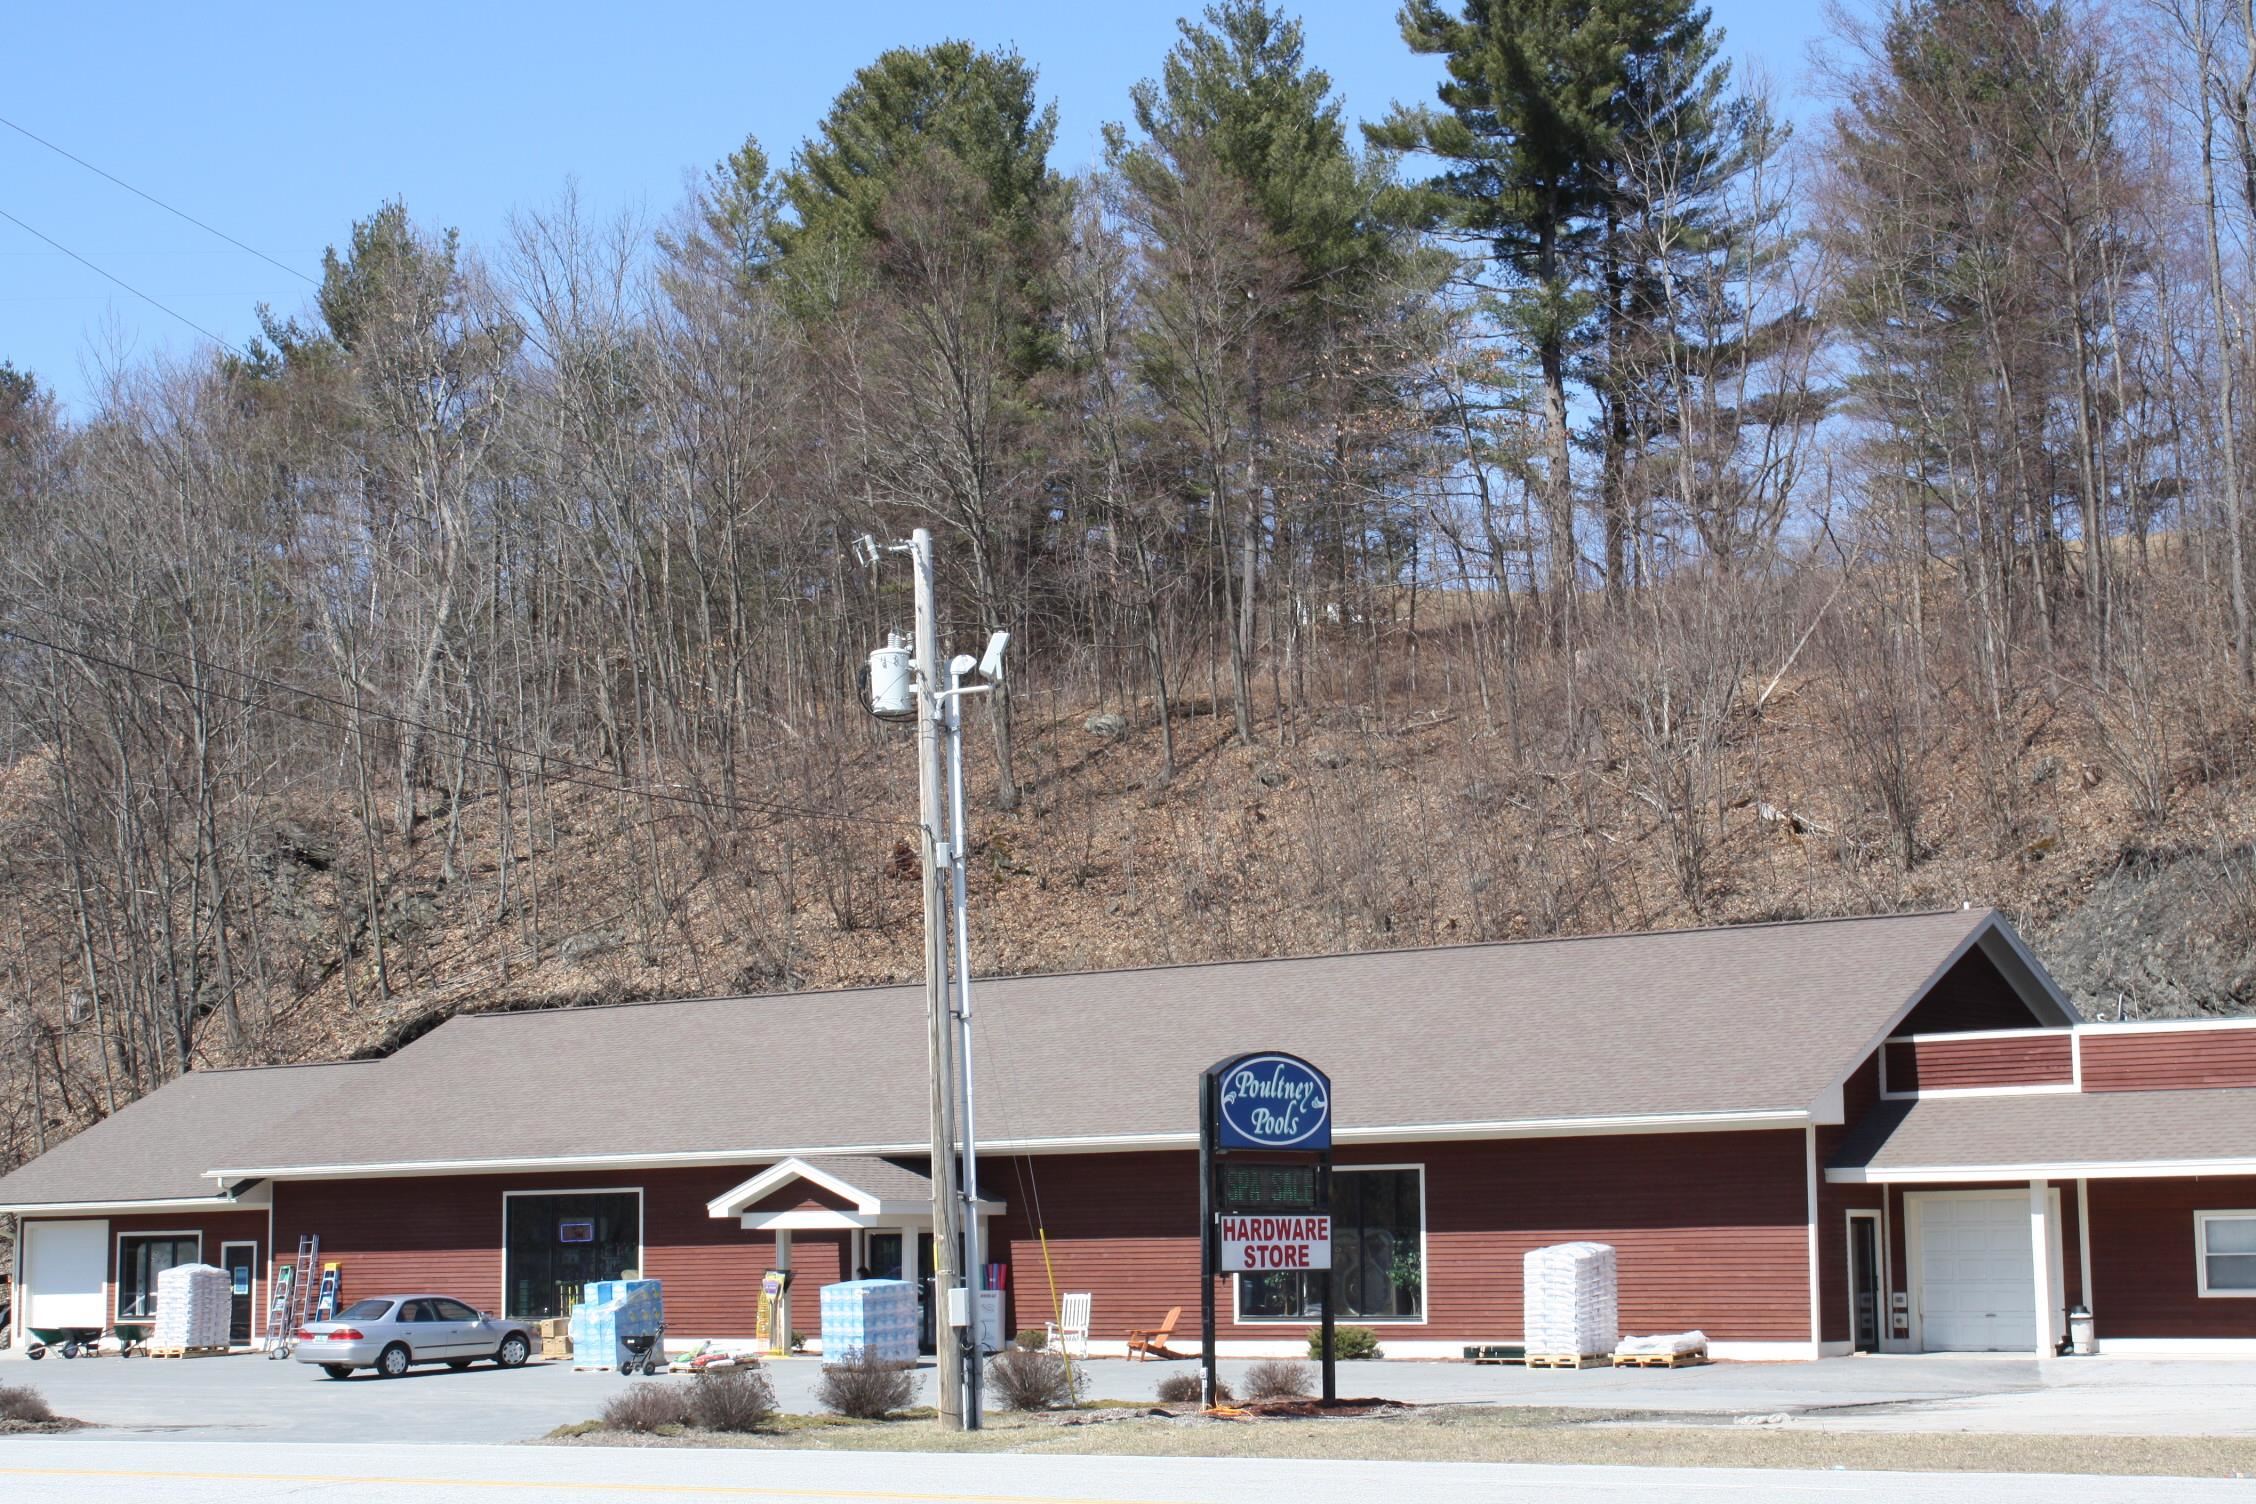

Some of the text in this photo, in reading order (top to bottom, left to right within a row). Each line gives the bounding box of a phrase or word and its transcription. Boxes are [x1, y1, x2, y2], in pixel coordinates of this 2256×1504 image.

[1235, 1064, 1313, 1113] Poultney
[1251, 1100, 1299, 1135] Pools
[1271, 1171, 1314, 1201] SALE
[1223, 1218, 1328, 1241] HARDWARE
[1244, 1245, 1309, 1268] STORE
